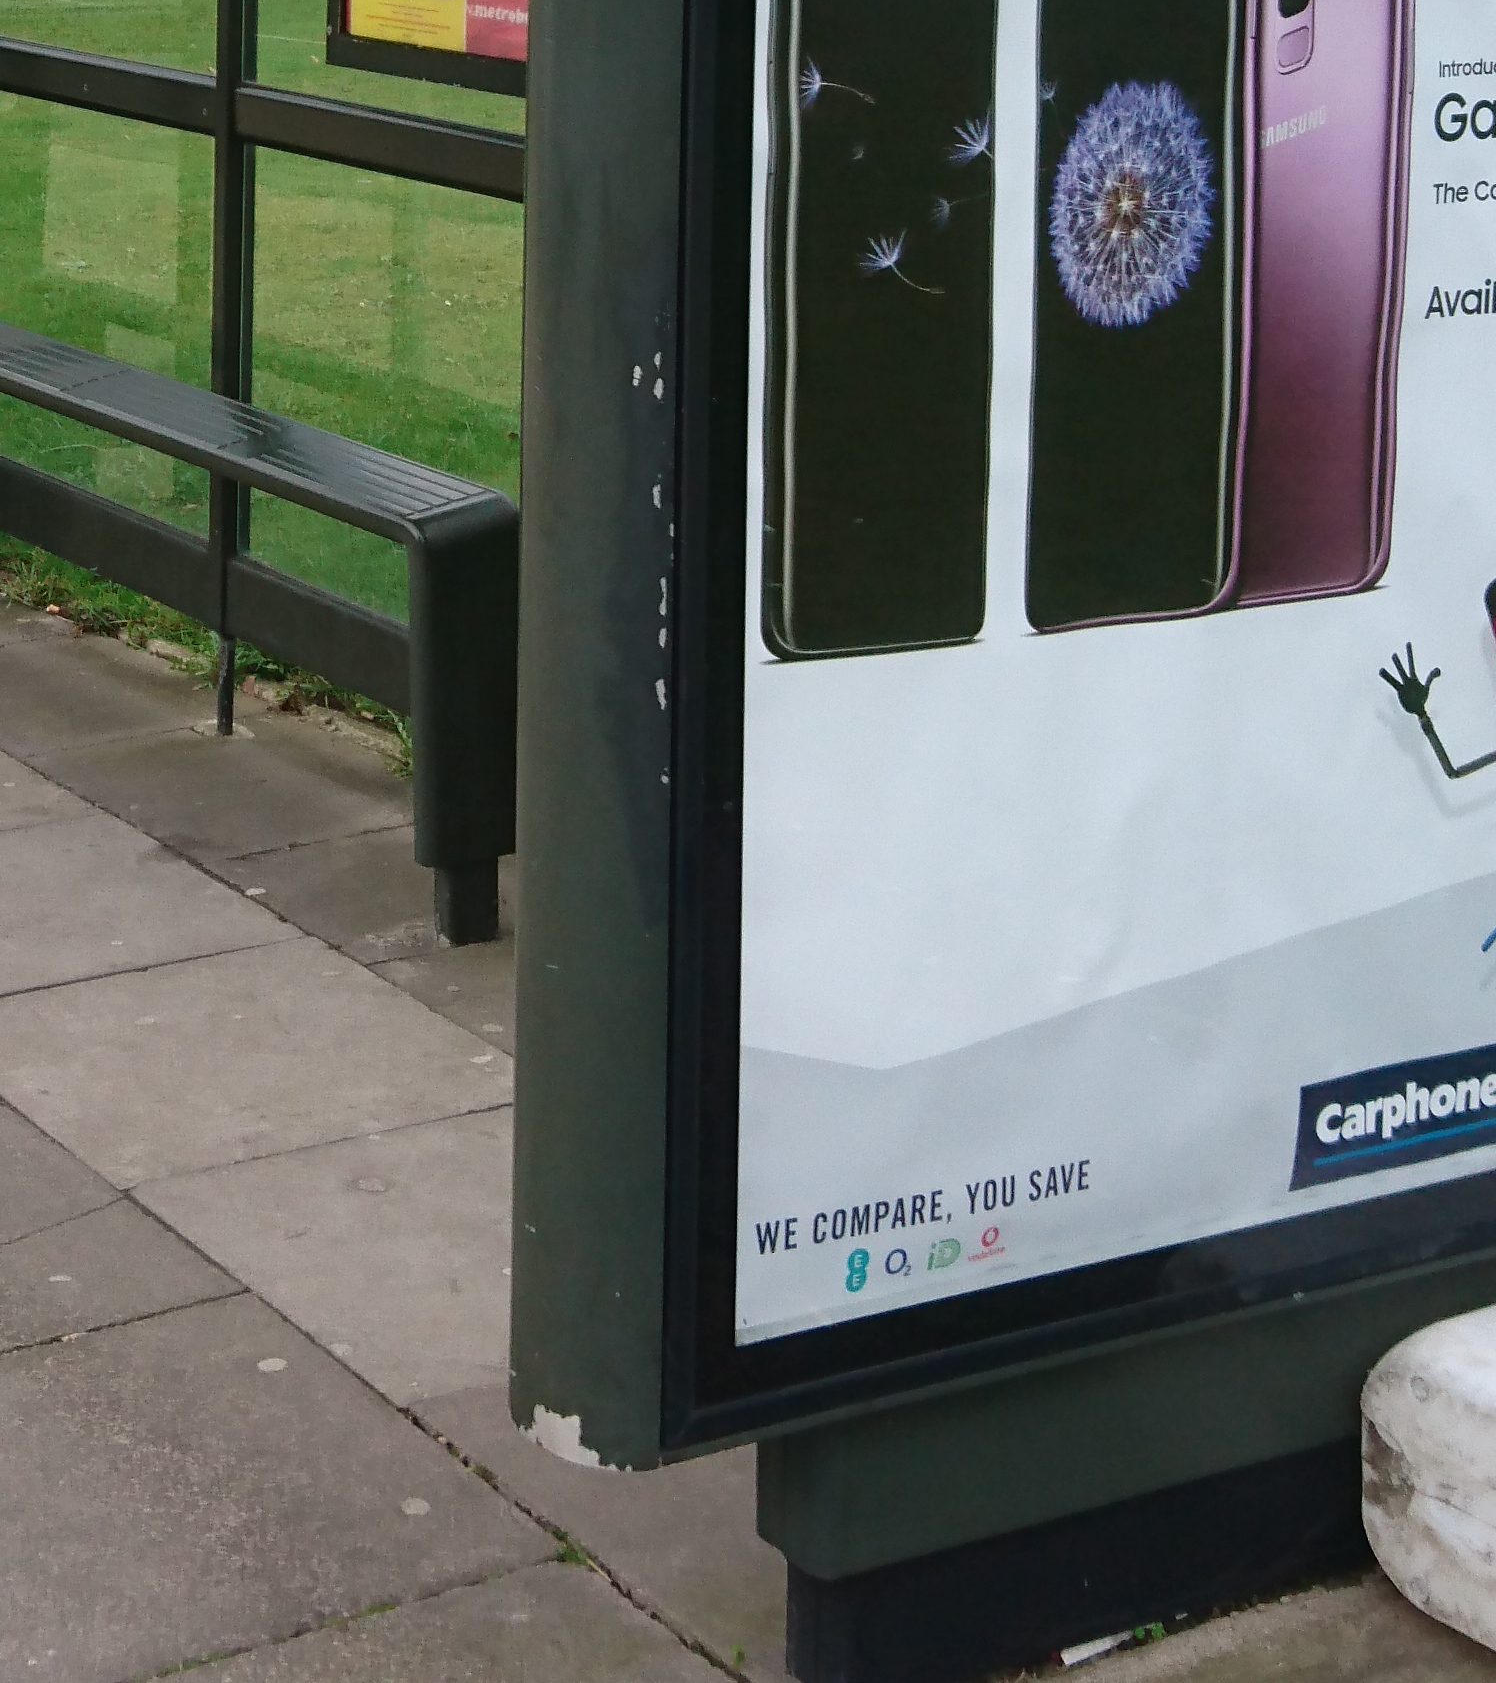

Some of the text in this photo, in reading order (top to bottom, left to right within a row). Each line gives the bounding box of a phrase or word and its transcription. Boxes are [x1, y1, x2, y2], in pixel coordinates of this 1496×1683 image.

[1433, 181, 1468, 205] The
[756, 1159, 1091, 1255] WE COMPARE, YOU SAVE
